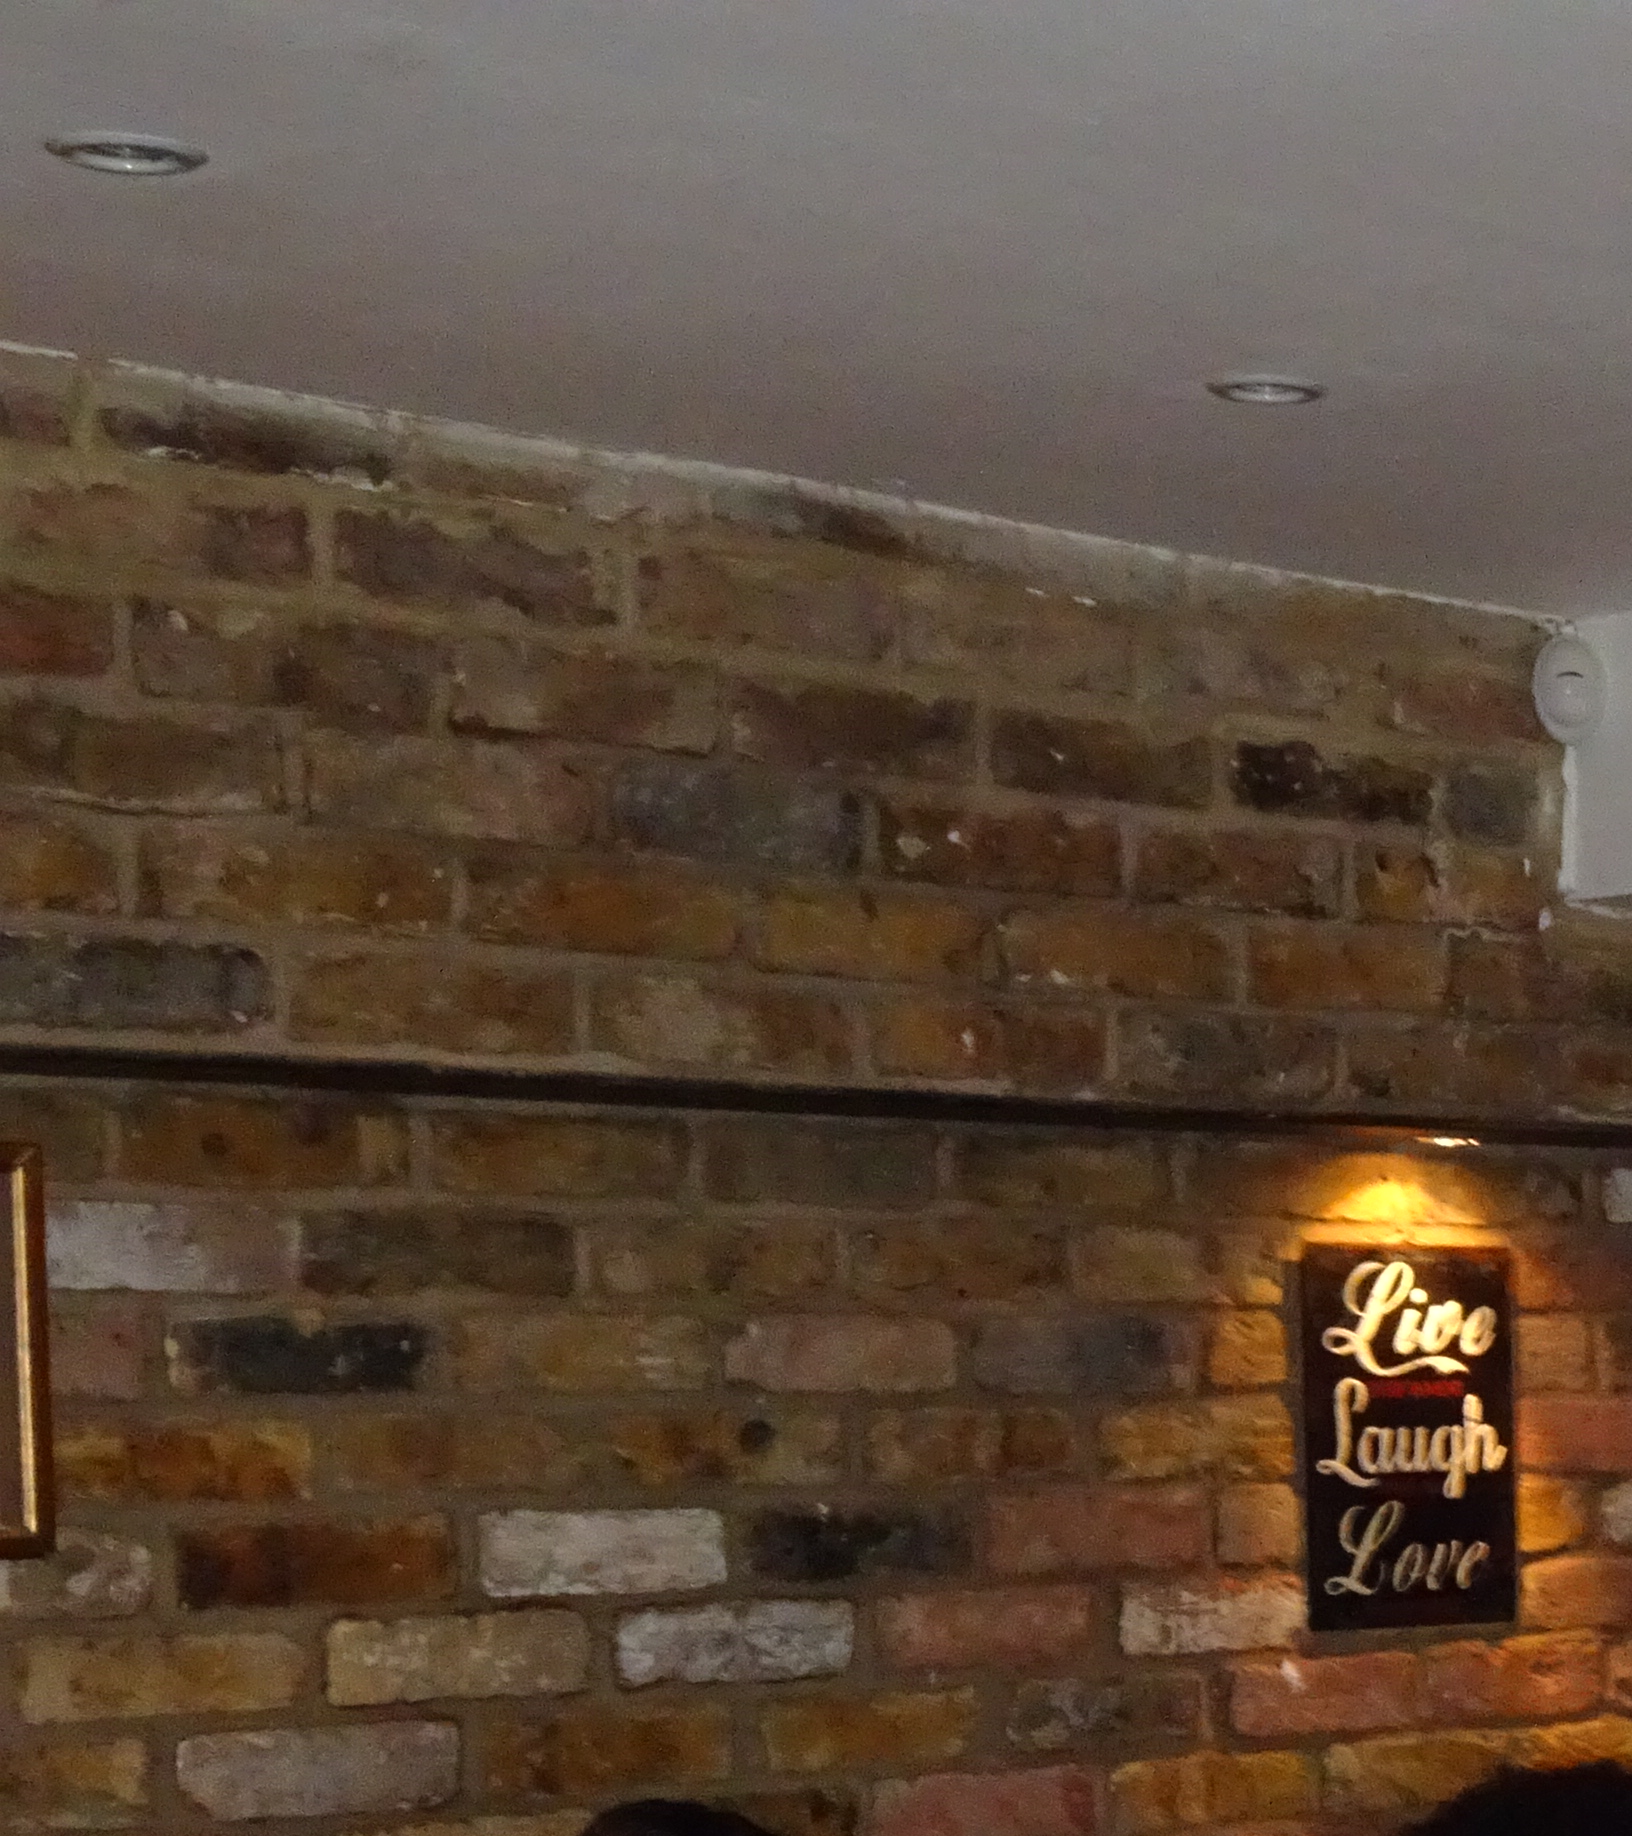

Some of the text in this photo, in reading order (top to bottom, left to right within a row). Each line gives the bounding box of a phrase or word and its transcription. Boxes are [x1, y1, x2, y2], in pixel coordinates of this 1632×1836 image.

[1321, 1261, 1497, 1377] Live
[1316, 1377, 1507, 1499] Laugh
[1324, 1499, 1491, 1596] Love
